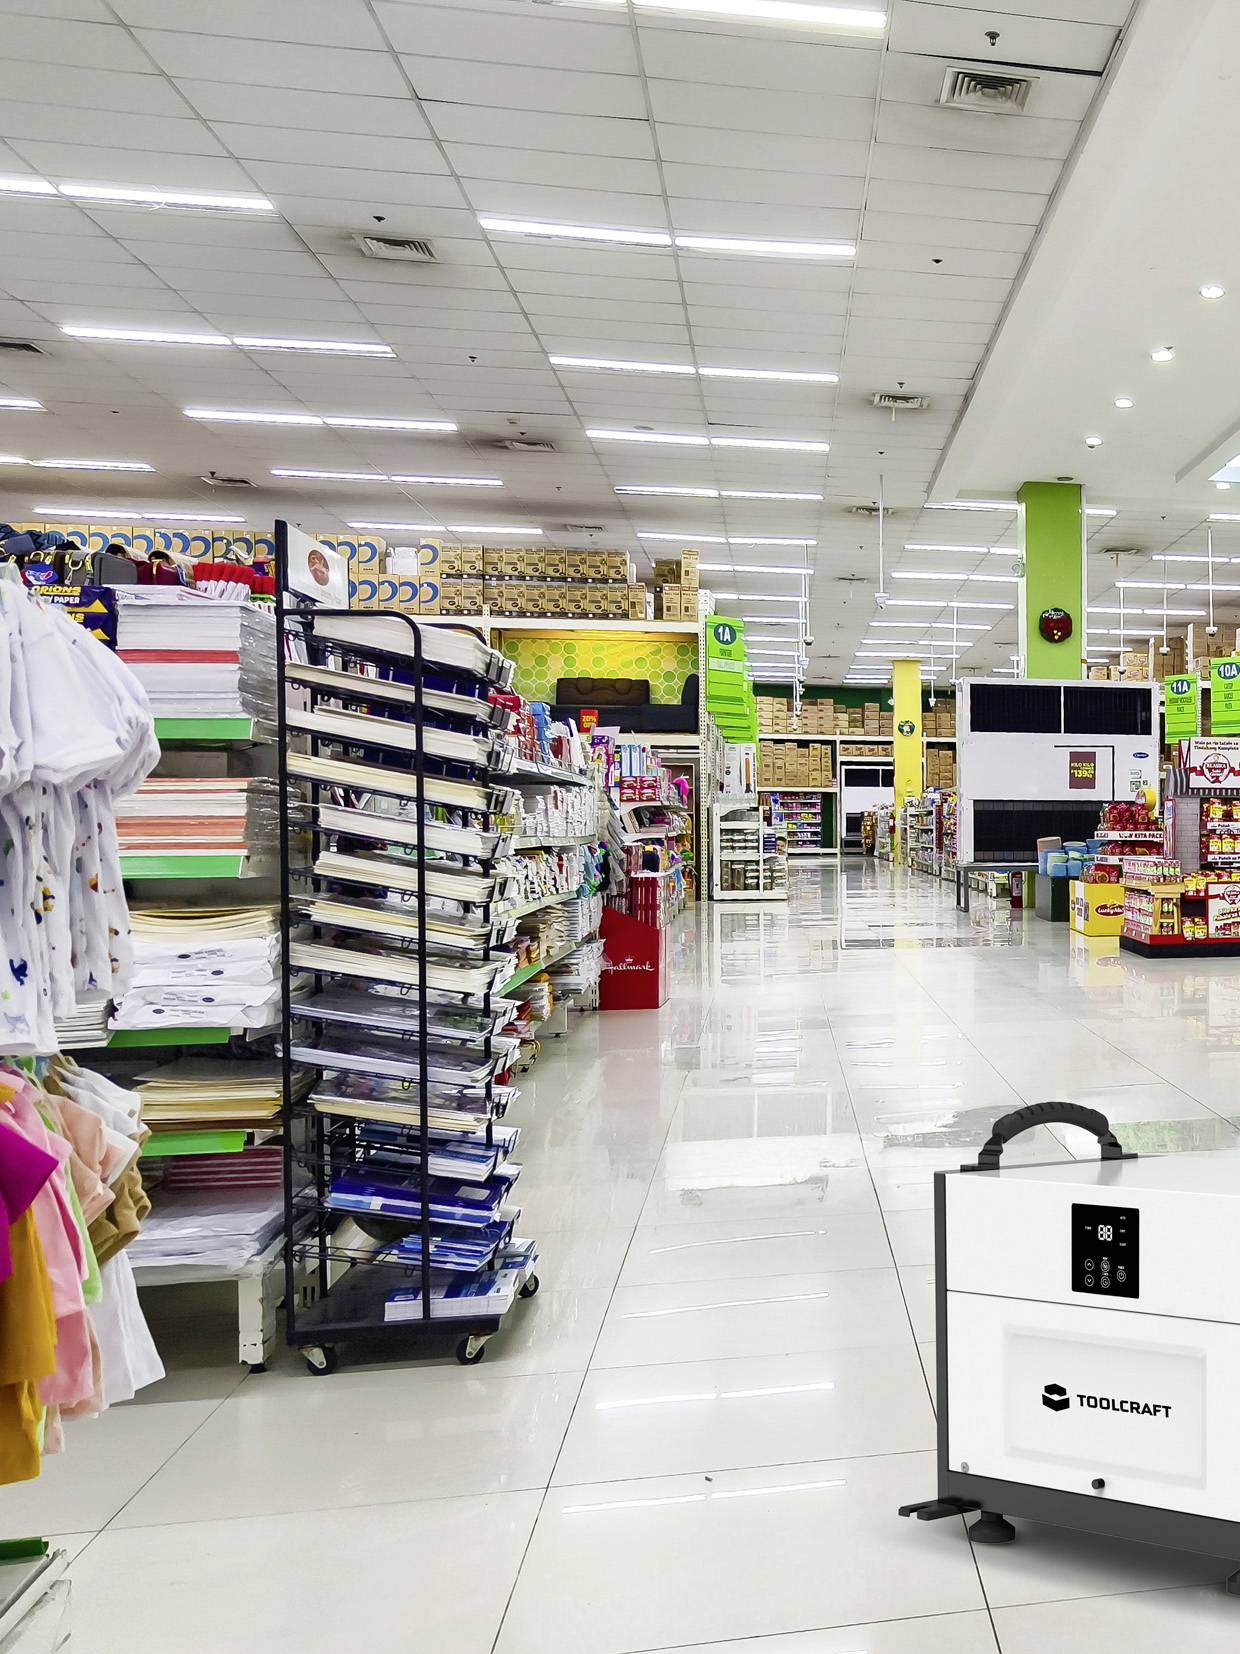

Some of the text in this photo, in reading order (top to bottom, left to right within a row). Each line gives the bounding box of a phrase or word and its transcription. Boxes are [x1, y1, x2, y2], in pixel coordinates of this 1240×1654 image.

[717, 626, 733, 642] 1A
[1219, 664, 1238, 677] 10A
[1172, 681, 1188, 694] 11A
[1098, 1225, 1113, 1241] 88
[1076, 1394, 1171, 1418] TOOLCRAFT
